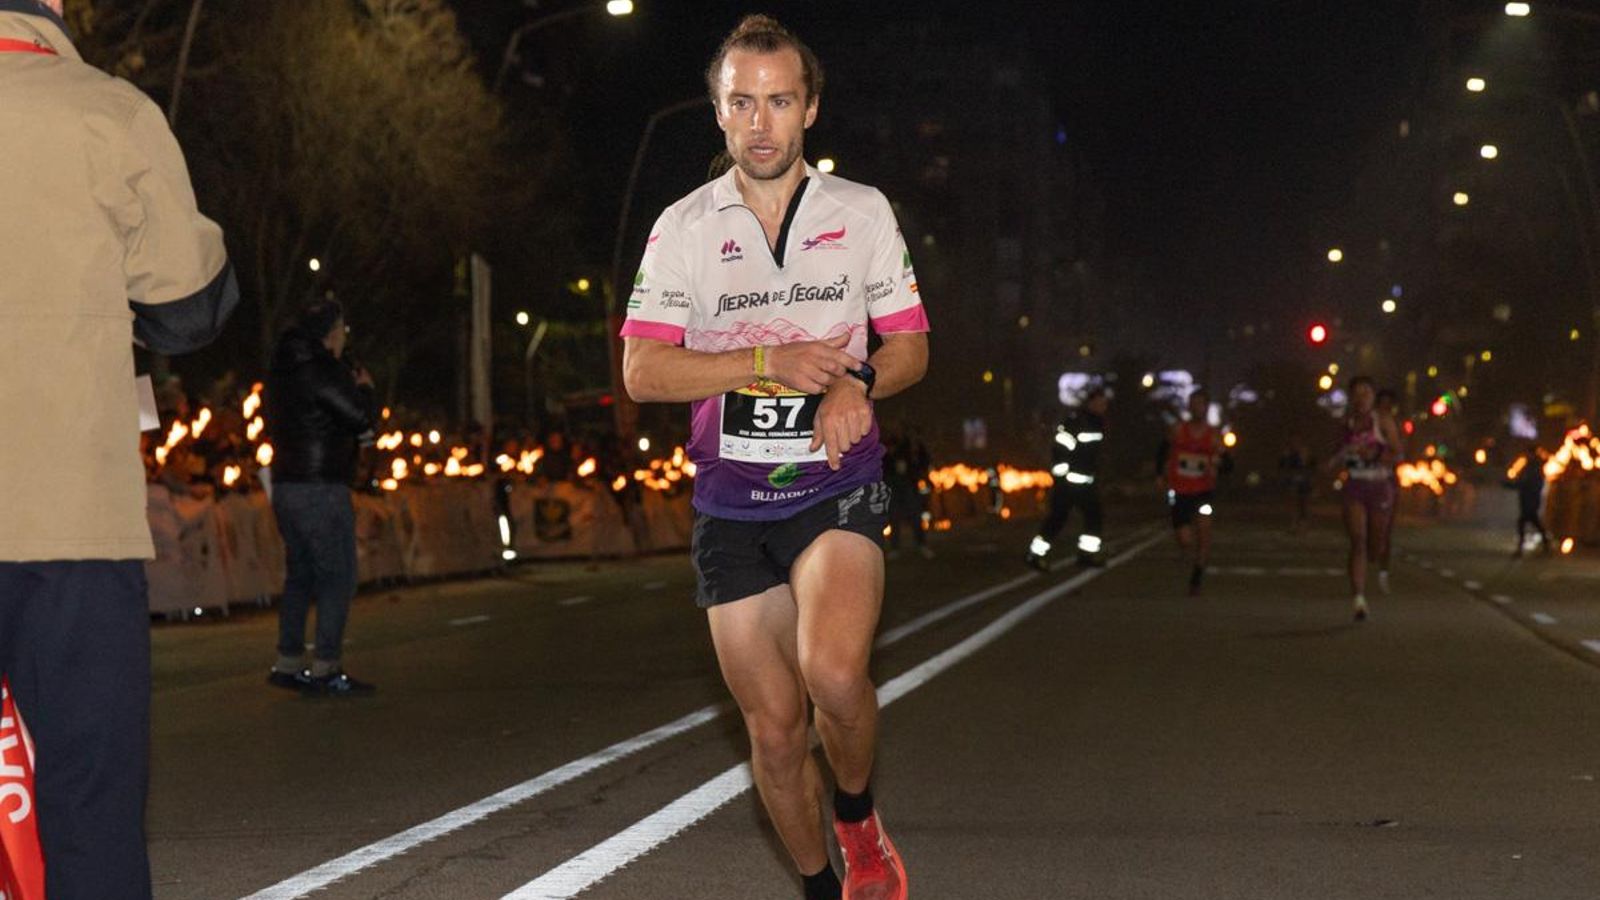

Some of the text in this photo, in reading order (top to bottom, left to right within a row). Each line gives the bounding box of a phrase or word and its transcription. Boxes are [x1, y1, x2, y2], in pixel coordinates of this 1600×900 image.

[714, 283, 845, 317] SIERRA DE SEGURA
[752, 398, 806, 429] 57
